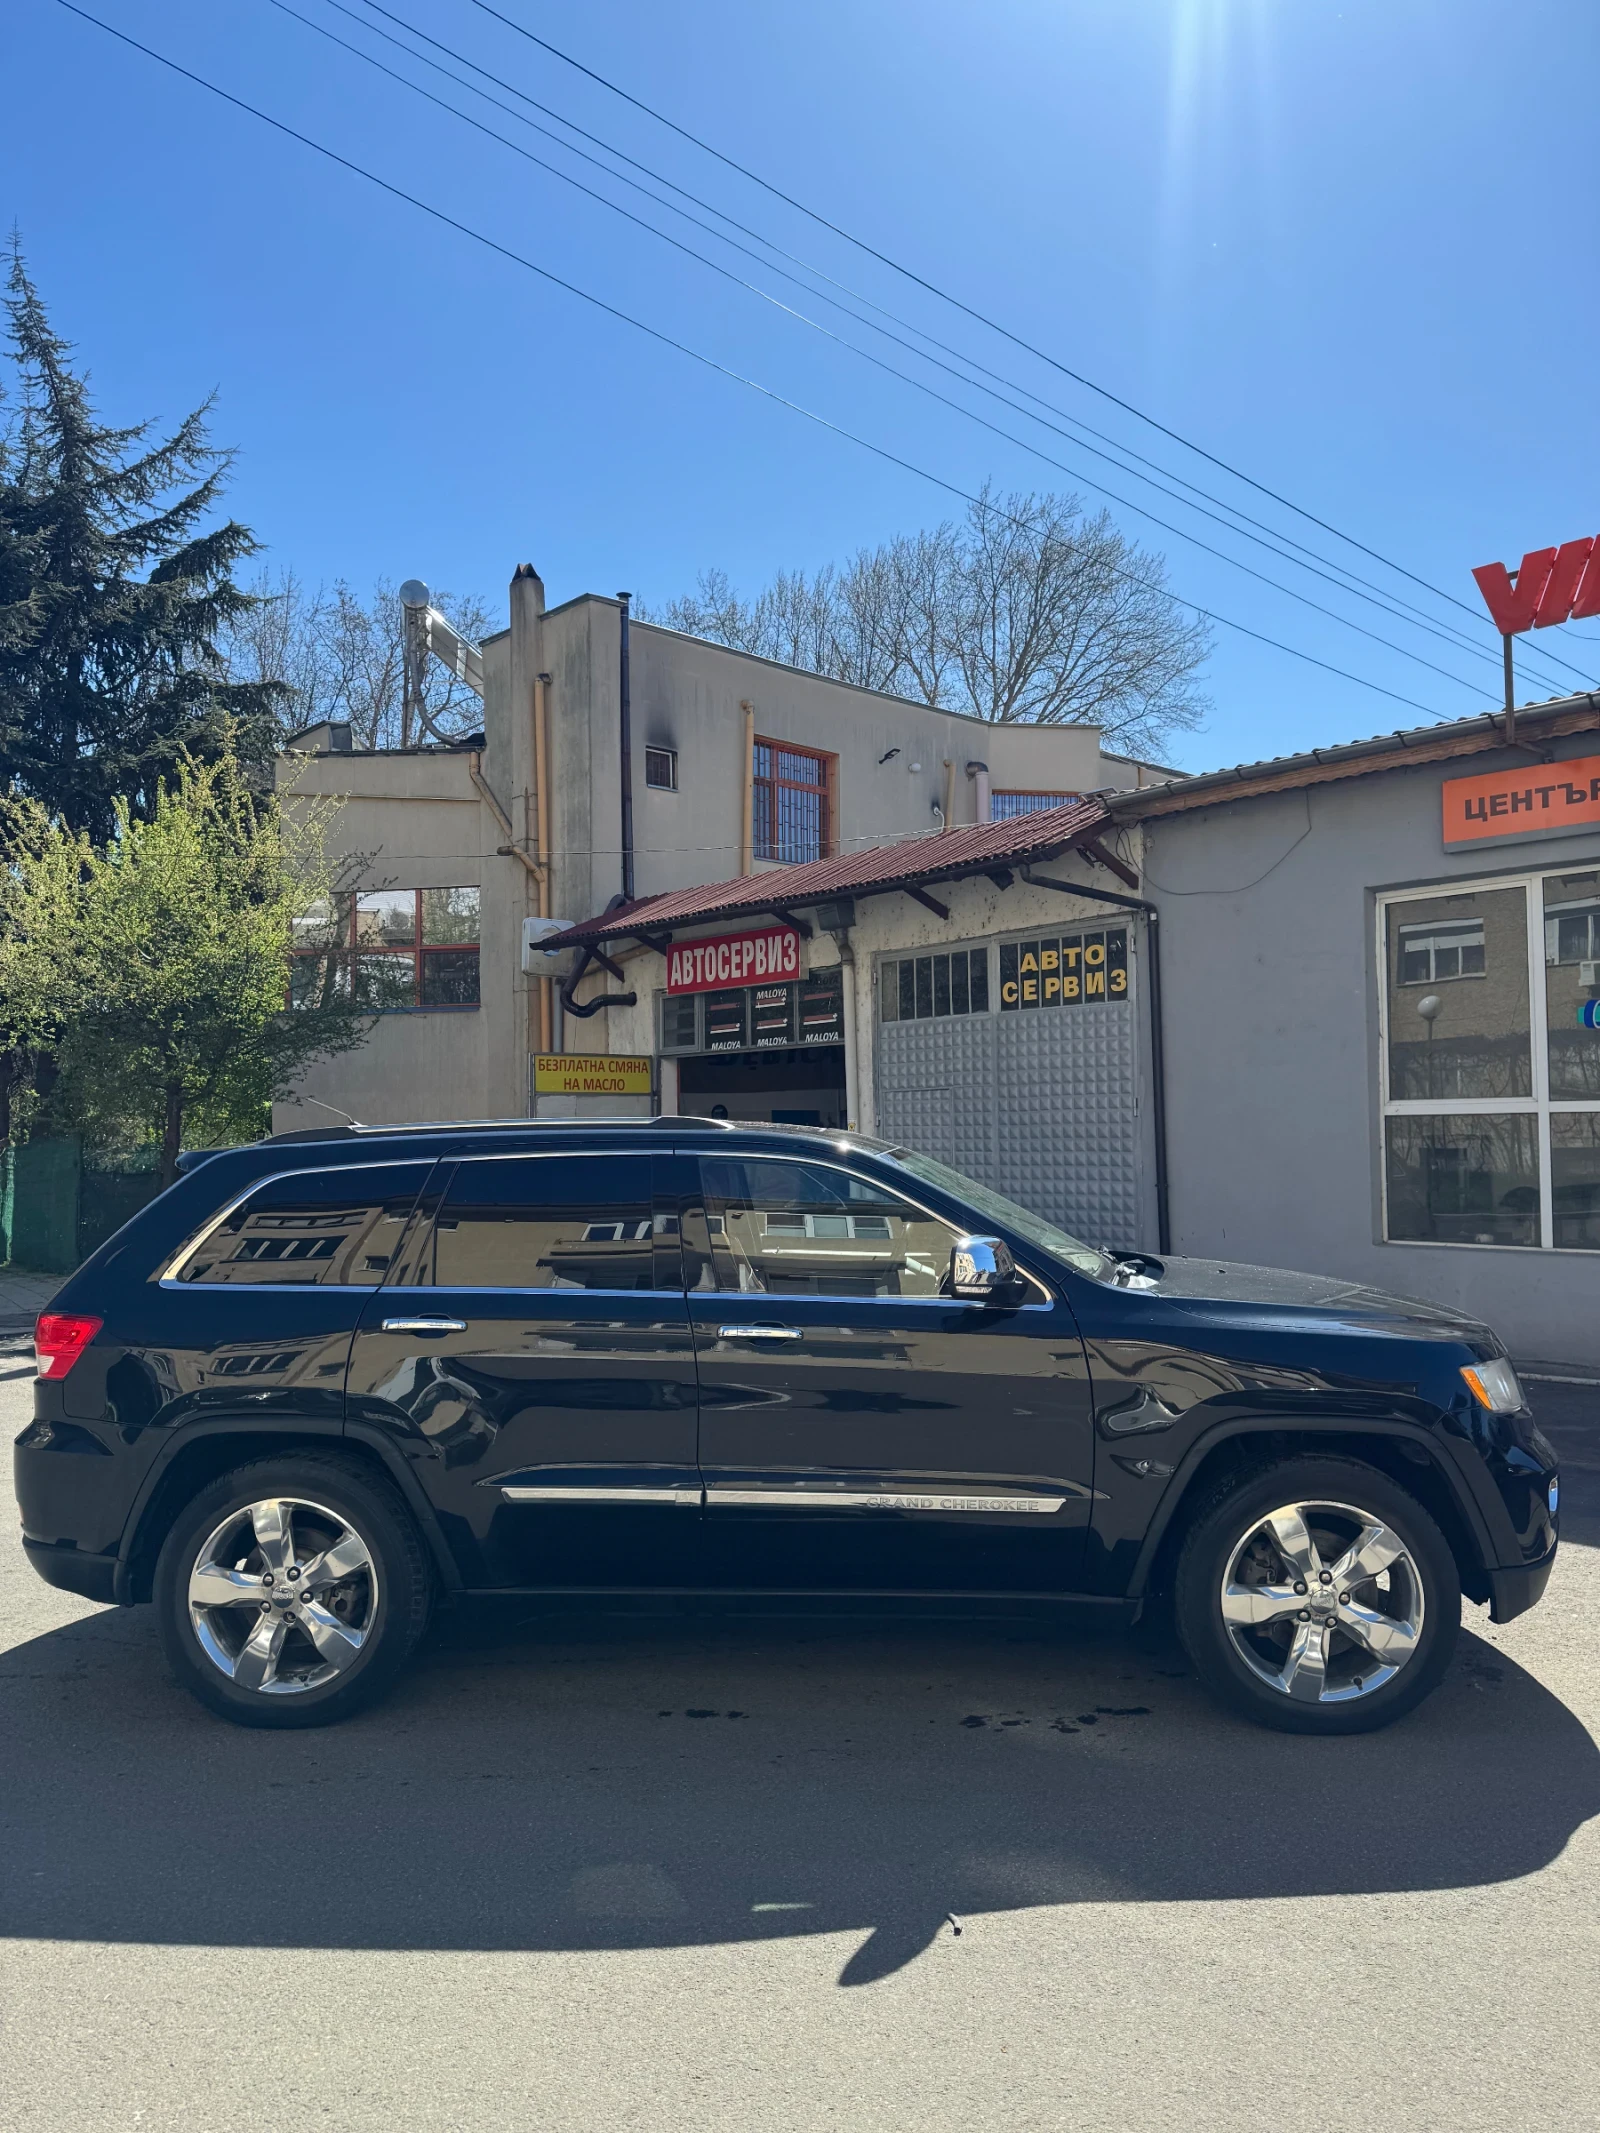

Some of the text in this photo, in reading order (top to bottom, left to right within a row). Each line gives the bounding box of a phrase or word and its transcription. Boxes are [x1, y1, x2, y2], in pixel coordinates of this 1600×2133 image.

[670, 932, 797, 987] АВТОСЕРВИЗ
[1020, 944, 1105, 973] АВТО
[1002, 968, 1127, 1003] СЕРВИЗ
[756, 987, 787, 1000] MALOYA
[756, 1036, 788, 1047] MALOYA
[804, 1031, 839, 1043] MALOYA
[711, 1040, 741, 1050] MALOYA
[538, 1058, 649, 1074] БЕЗПЛАТНА СМЯНА
[563, 1078, 625, 1091] НА МАСЛО
[866, 1496, 1040, 1512] GRAND CHEROKEE
